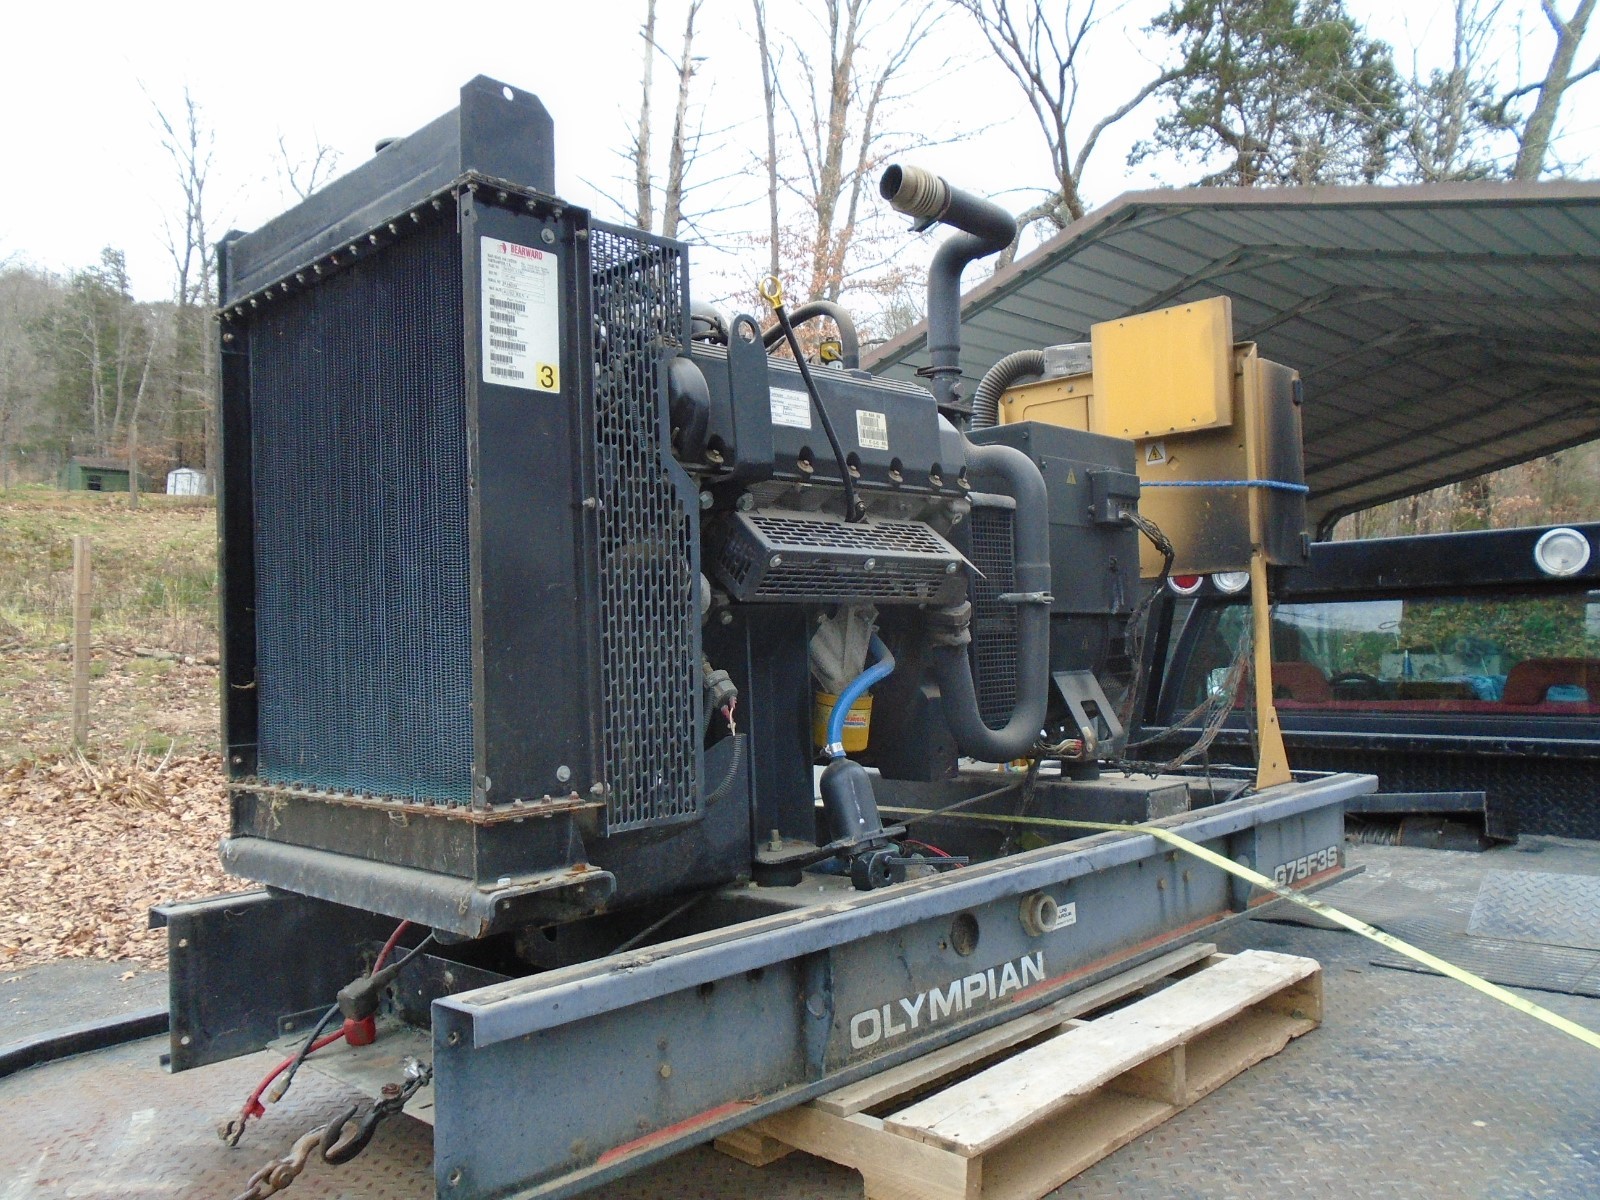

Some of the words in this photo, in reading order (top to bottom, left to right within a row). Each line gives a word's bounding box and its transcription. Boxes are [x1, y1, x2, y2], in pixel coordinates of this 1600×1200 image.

[511, 244, 543, 260] BEARWARD
[540, 365, 554, 388] 3
[1274, 845, 1338, 886] G75F3S
[850, 951, 1046, 1050] OLYMPIAN
